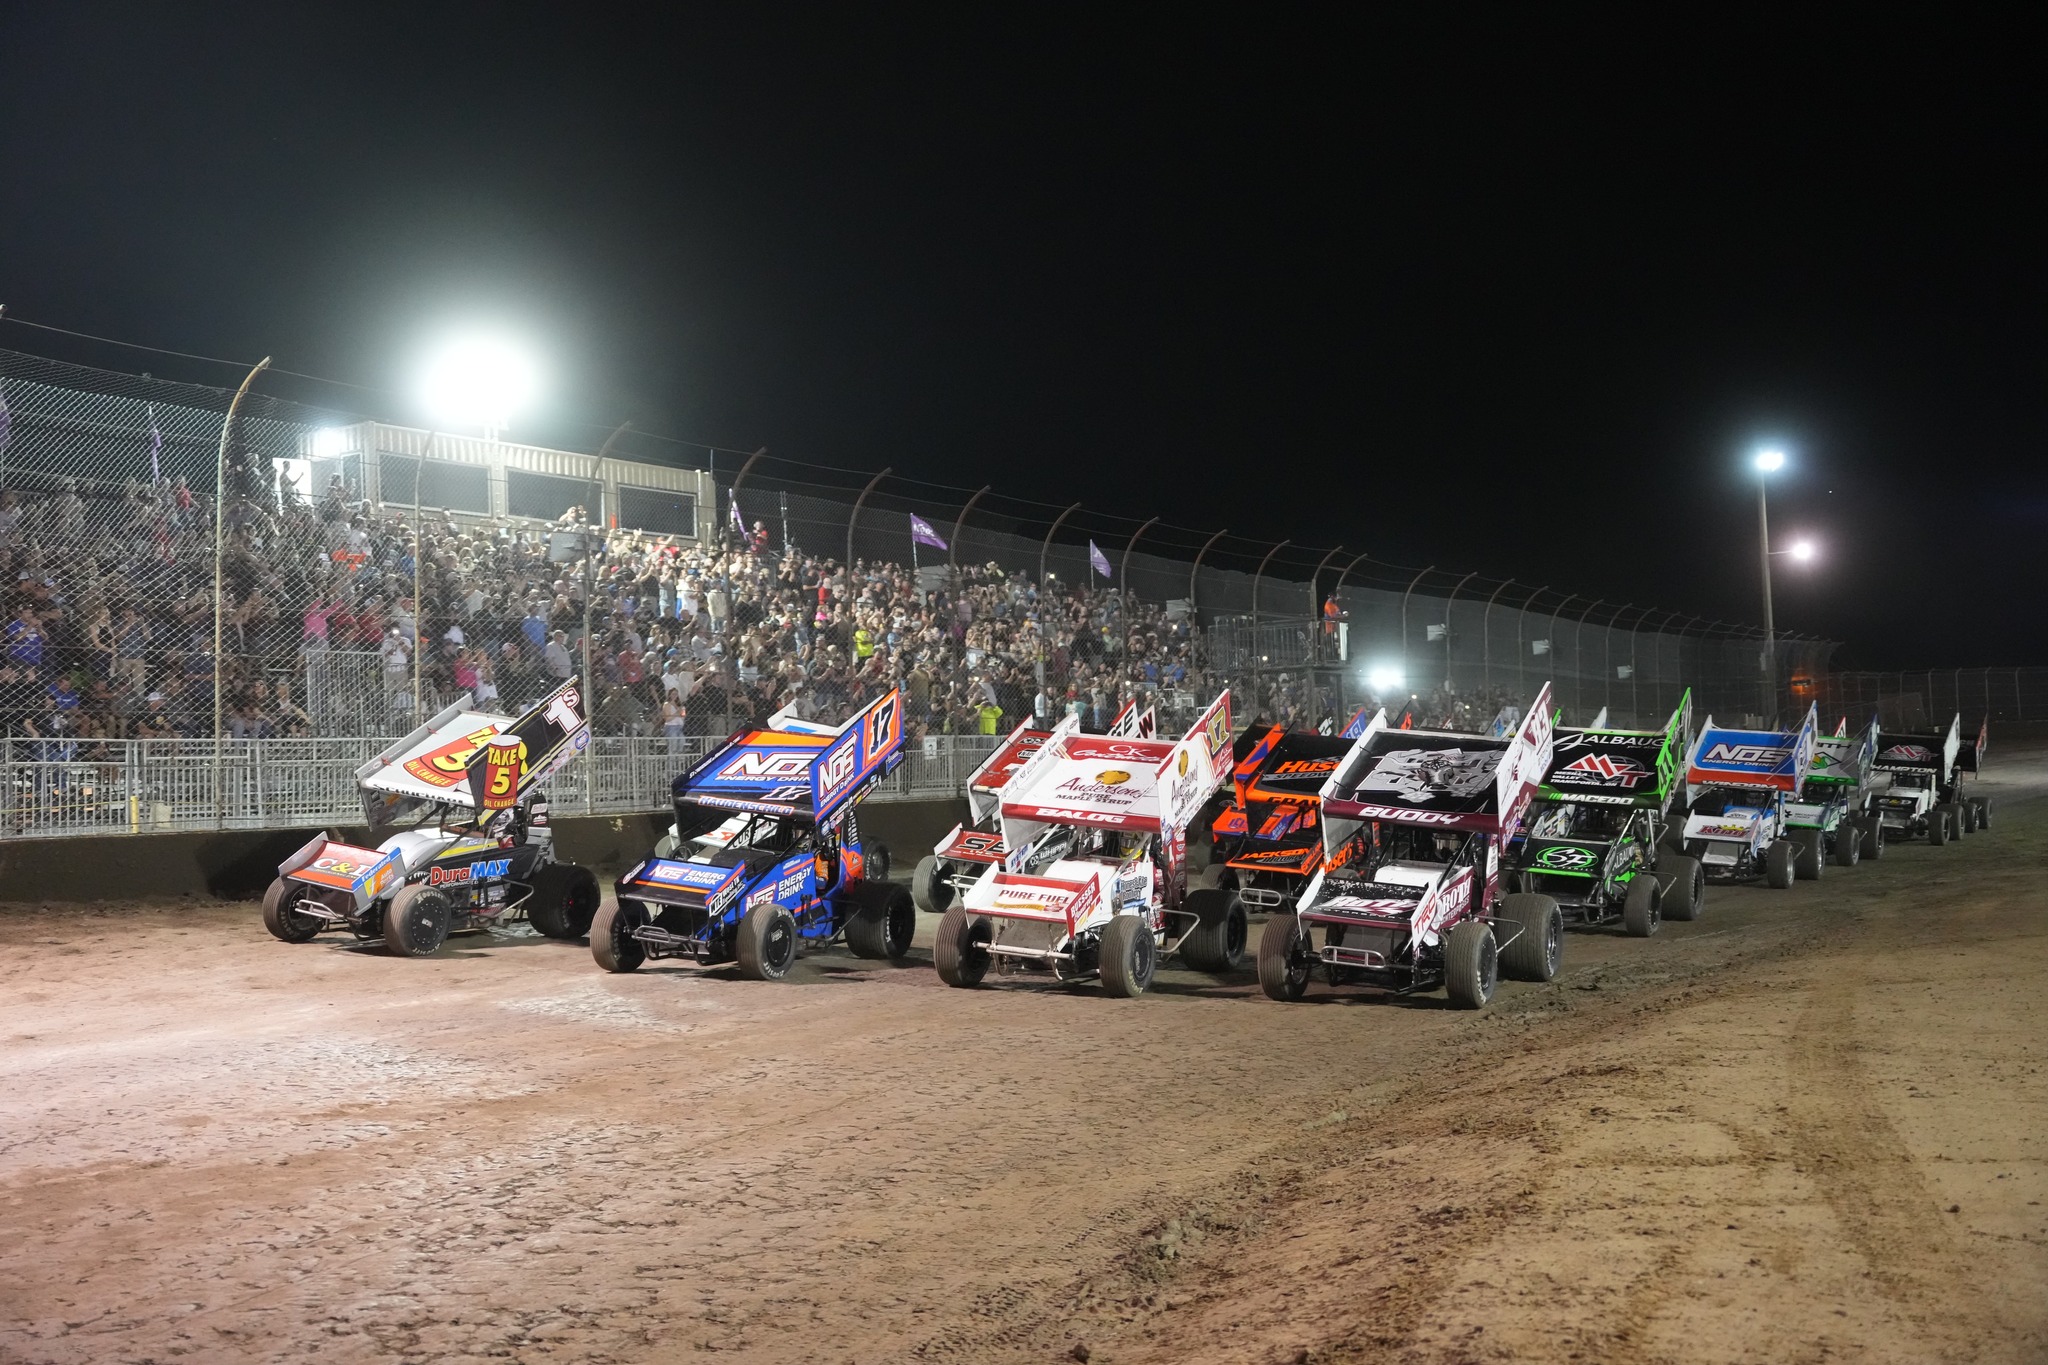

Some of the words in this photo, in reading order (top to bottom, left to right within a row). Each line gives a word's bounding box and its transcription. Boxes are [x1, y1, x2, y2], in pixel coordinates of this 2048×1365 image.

[870, 698, 895, 755] 17
[488, 747, 518, 766] TAKE
[1108, 744, 1152, 757] CK
[1705, 743, 1794, 763] NOS
[718, 752, 818, 776] NO
[819, 731, 858, 800] NOS
[416, 769, 451, 786] CHANGE
[490, 767, 511, 795] 5
[1274, 772, 1333, 780] SPEEDW
[1702, 780, 1778, 790] WINDOM
[760, 785, 812, 801] 17
[820, 785, 841, 808] ENERGY
[1055, 794, 1093, 802] MAPLE
[1094, 798, 1133, 806] SYRUP
[1081, 792, 1112, 800] PURE
[1267, 796, 1322, 807] GRAV
[1561, 793, 1635, 805] MACEDO
[483, 798, 493, 807] OIL
[493, 798, 515, 808] CHANGE
[699, 796, 794, 815] HAUDENSCHILD
[1035, 807, 1127, 825] BALOG
[1358, 806, 1465, 825] BUDDY
[361, 855, 391, 882] Federated
[381, 868, 393, 879] Auto
[429, 859, 511, 886] DuraMAX
[648, 864, 691, 880] NOS
[688, 870, 727, 881] ENERG
[682, 875, 720, 885] DRINK
[778, 866, 813, 892] ENERGY
[776, 879, 805, 902] DRINK
[998, 889, 1035, 900] PURE
[1037, 893, 1070, 905] FUEL
[1442, 875, 1472, 914] ROTH
[1414, 891, 1436, 935] TRD
